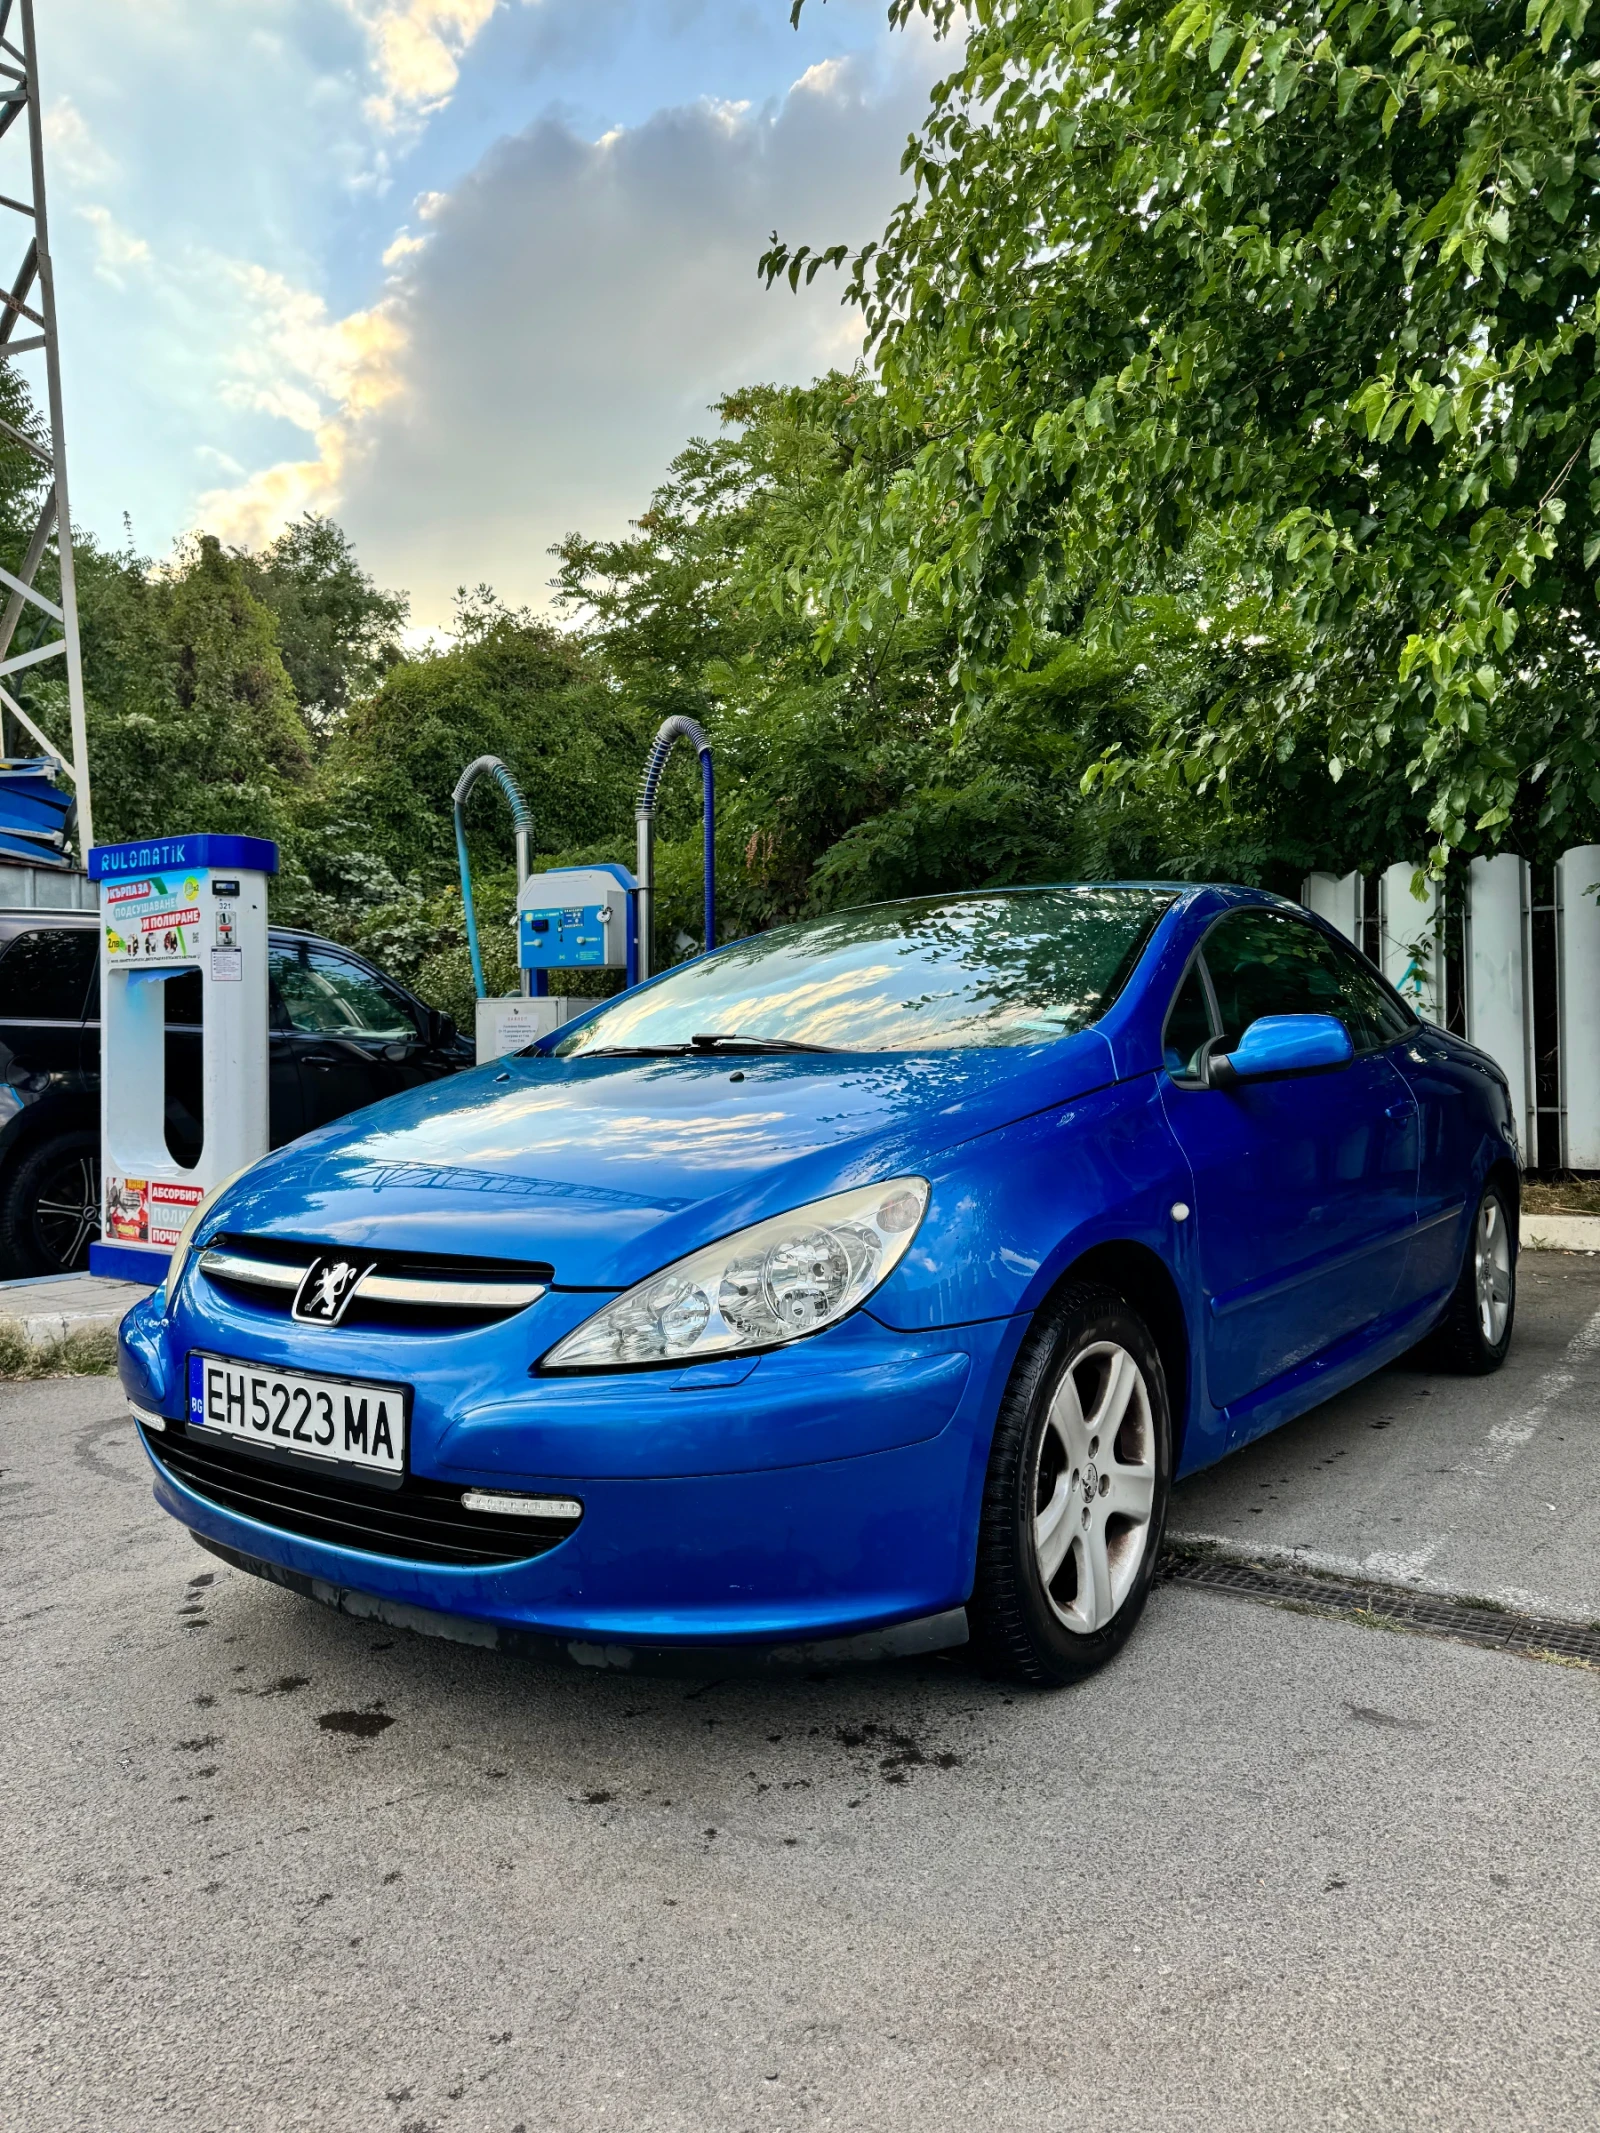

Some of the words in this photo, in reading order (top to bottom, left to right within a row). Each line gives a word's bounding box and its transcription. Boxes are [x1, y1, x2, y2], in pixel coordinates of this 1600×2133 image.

[109, 885, 137, 900] КЪРПА
[138, 882, 149, 894] ЗА
[115, 898, 176, 918] ПОДСУШАВАНЕ
[219, 902, 231, 910] 321
[142, 919, 150, 930] И
[151, 910, 199, 929] ПОЛИРАНЕ
[152, 1186, 203, 1202] АБСОРБИРА
[191, 1396, 203, 1414] BG
